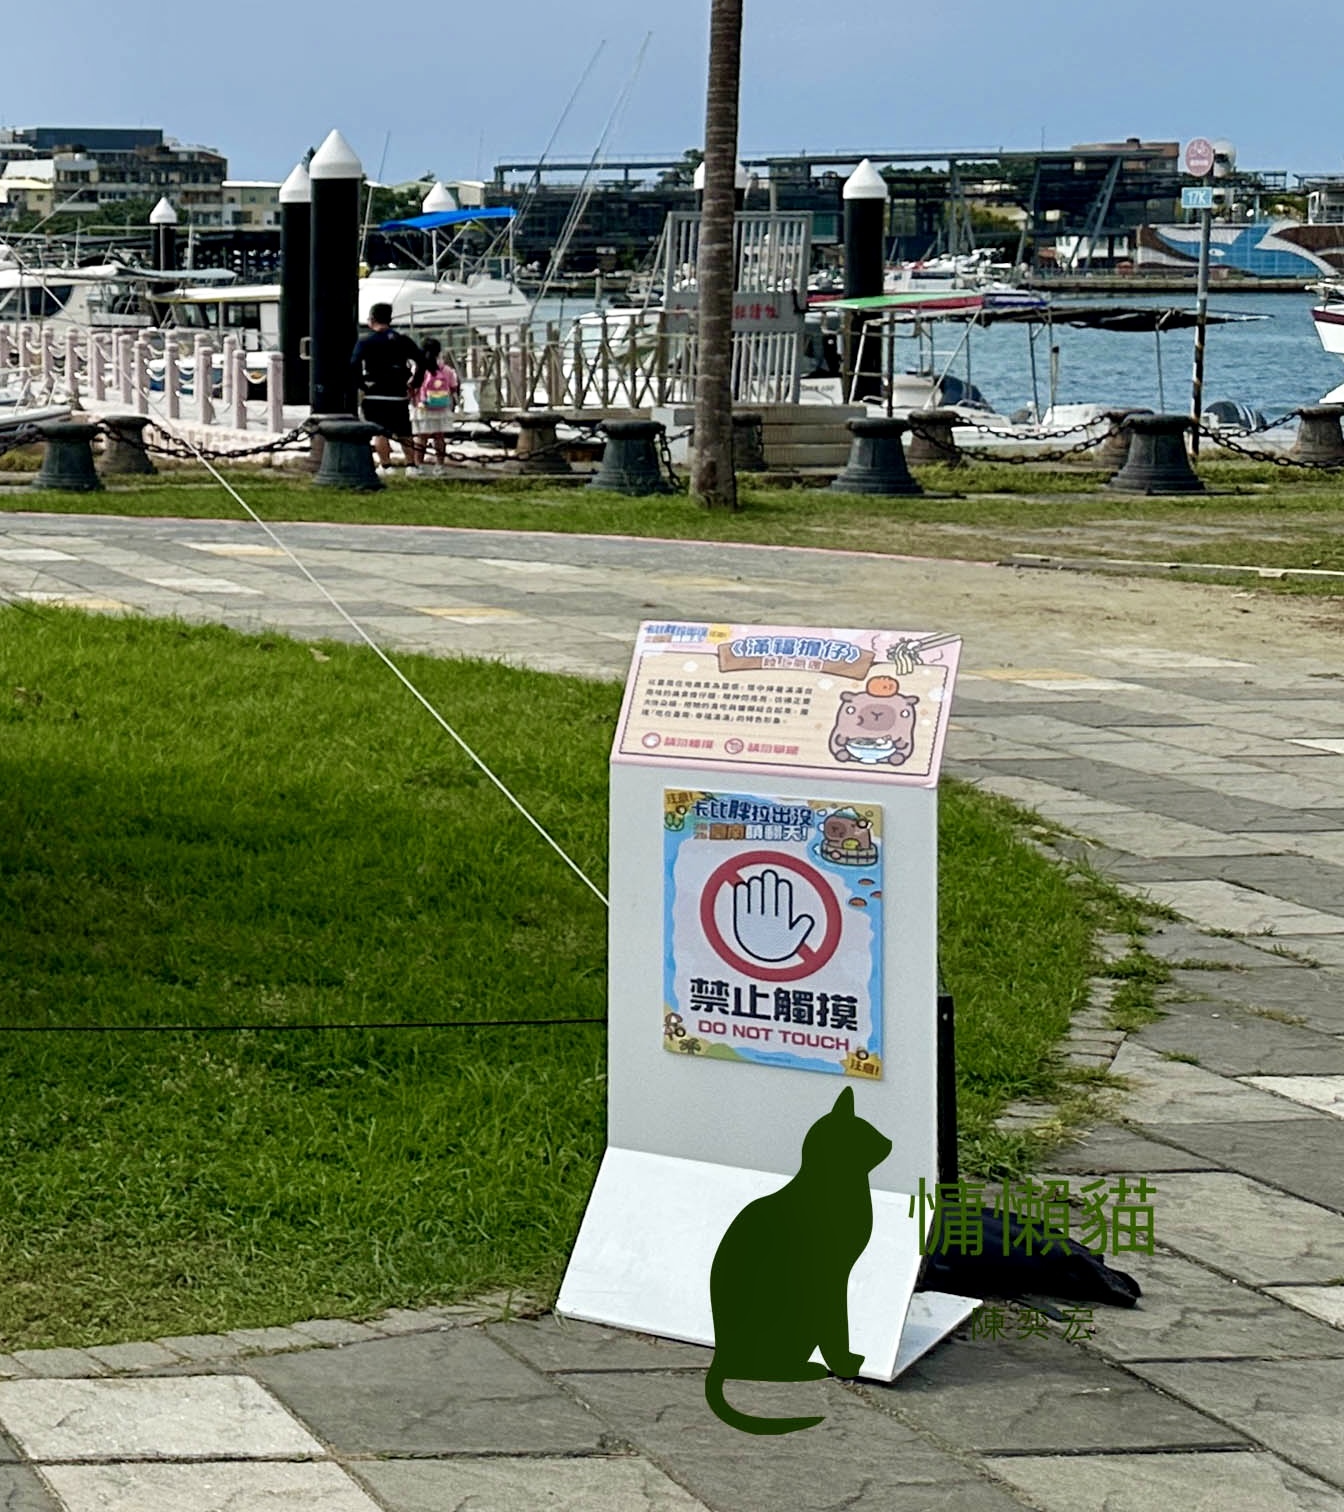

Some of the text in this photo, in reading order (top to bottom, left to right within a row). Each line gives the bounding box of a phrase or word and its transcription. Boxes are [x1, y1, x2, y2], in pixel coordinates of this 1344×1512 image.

[1187, 189, 1207, 205] 17K
[689, 977, 859, 1032] 禁止觸摸
[698, 1020, 849, 1052] DO NOT TOUCH
